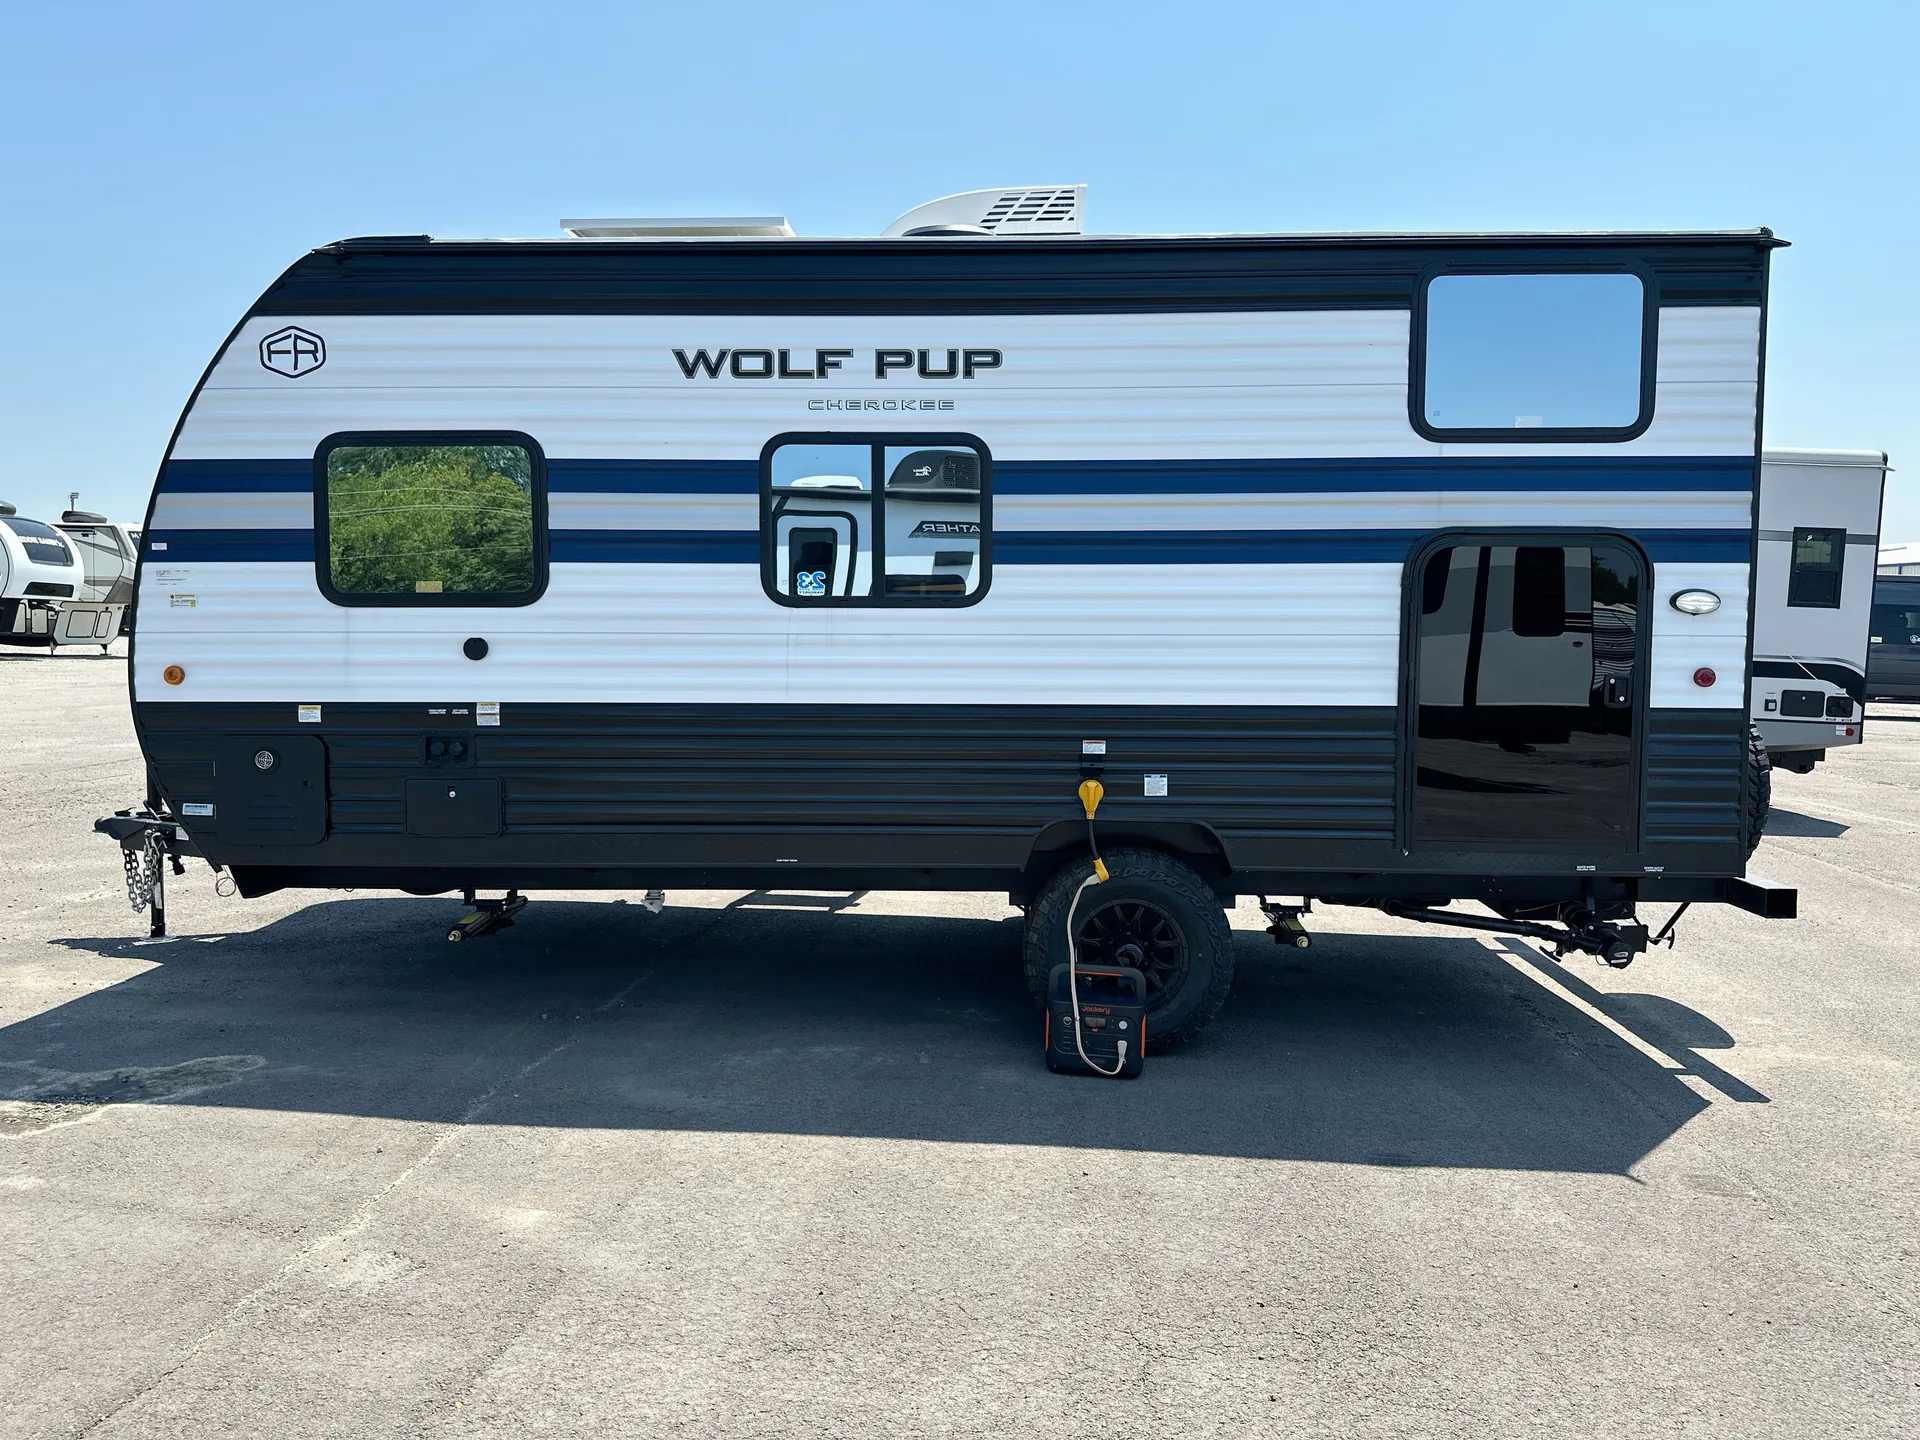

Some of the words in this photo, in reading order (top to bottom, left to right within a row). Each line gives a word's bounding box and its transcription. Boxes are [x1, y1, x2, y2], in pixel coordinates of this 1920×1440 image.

[266, 332, 319, 372] FR
[671, 348, 854, 379] WOLF
[875, 348, 1003, 379] PUP
[808, 399, 954, 411] CHEROKEE
[1082, 1005, 1110, 1015] Jackery
